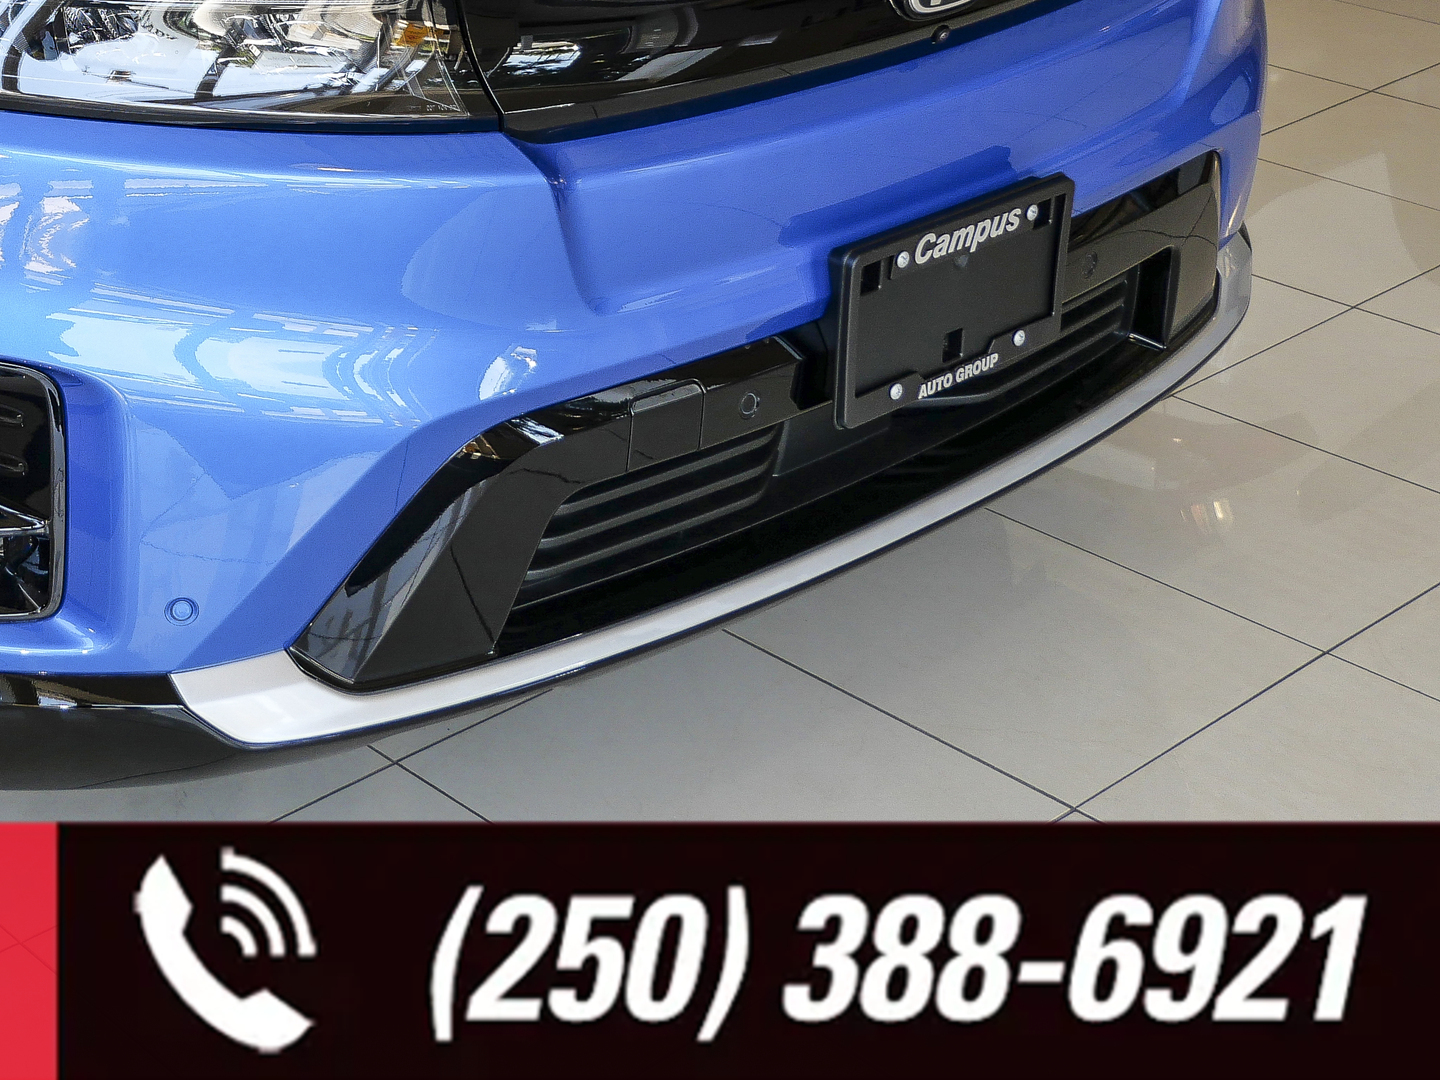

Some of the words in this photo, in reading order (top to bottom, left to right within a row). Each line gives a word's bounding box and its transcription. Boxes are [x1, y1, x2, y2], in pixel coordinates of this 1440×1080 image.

[915, 208, 1022, 265] Campus
[918, 373, 953, 400] AUTO
[955, 353, 999, 383] GROUP
